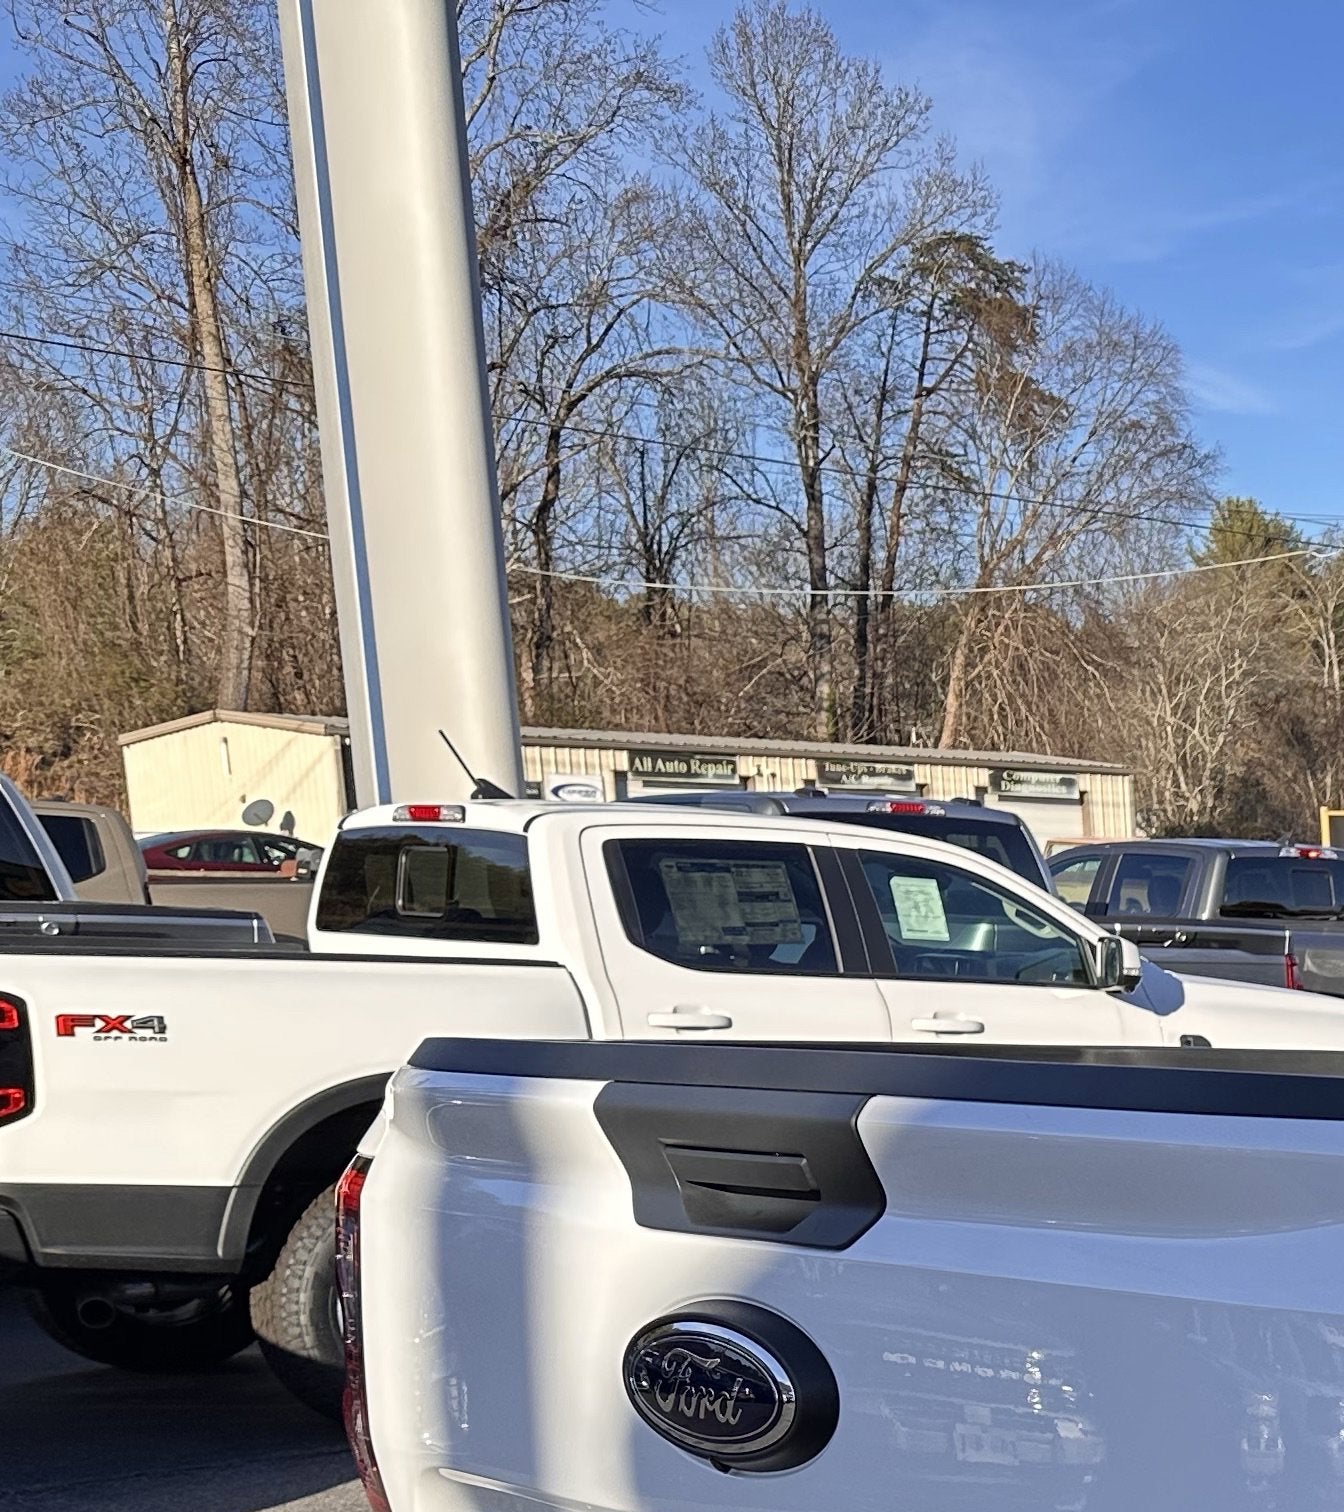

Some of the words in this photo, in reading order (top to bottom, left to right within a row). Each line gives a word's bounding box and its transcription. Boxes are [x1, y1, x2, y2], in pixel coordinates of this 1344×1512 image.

[632, 756, 652, 773] All
[654, 757, 688, 774] Auto
[690, 758, 734, 778] Repair
[55, 1013, 167, 1036] FX4
[654, 1347, 744, 1425] Ford
